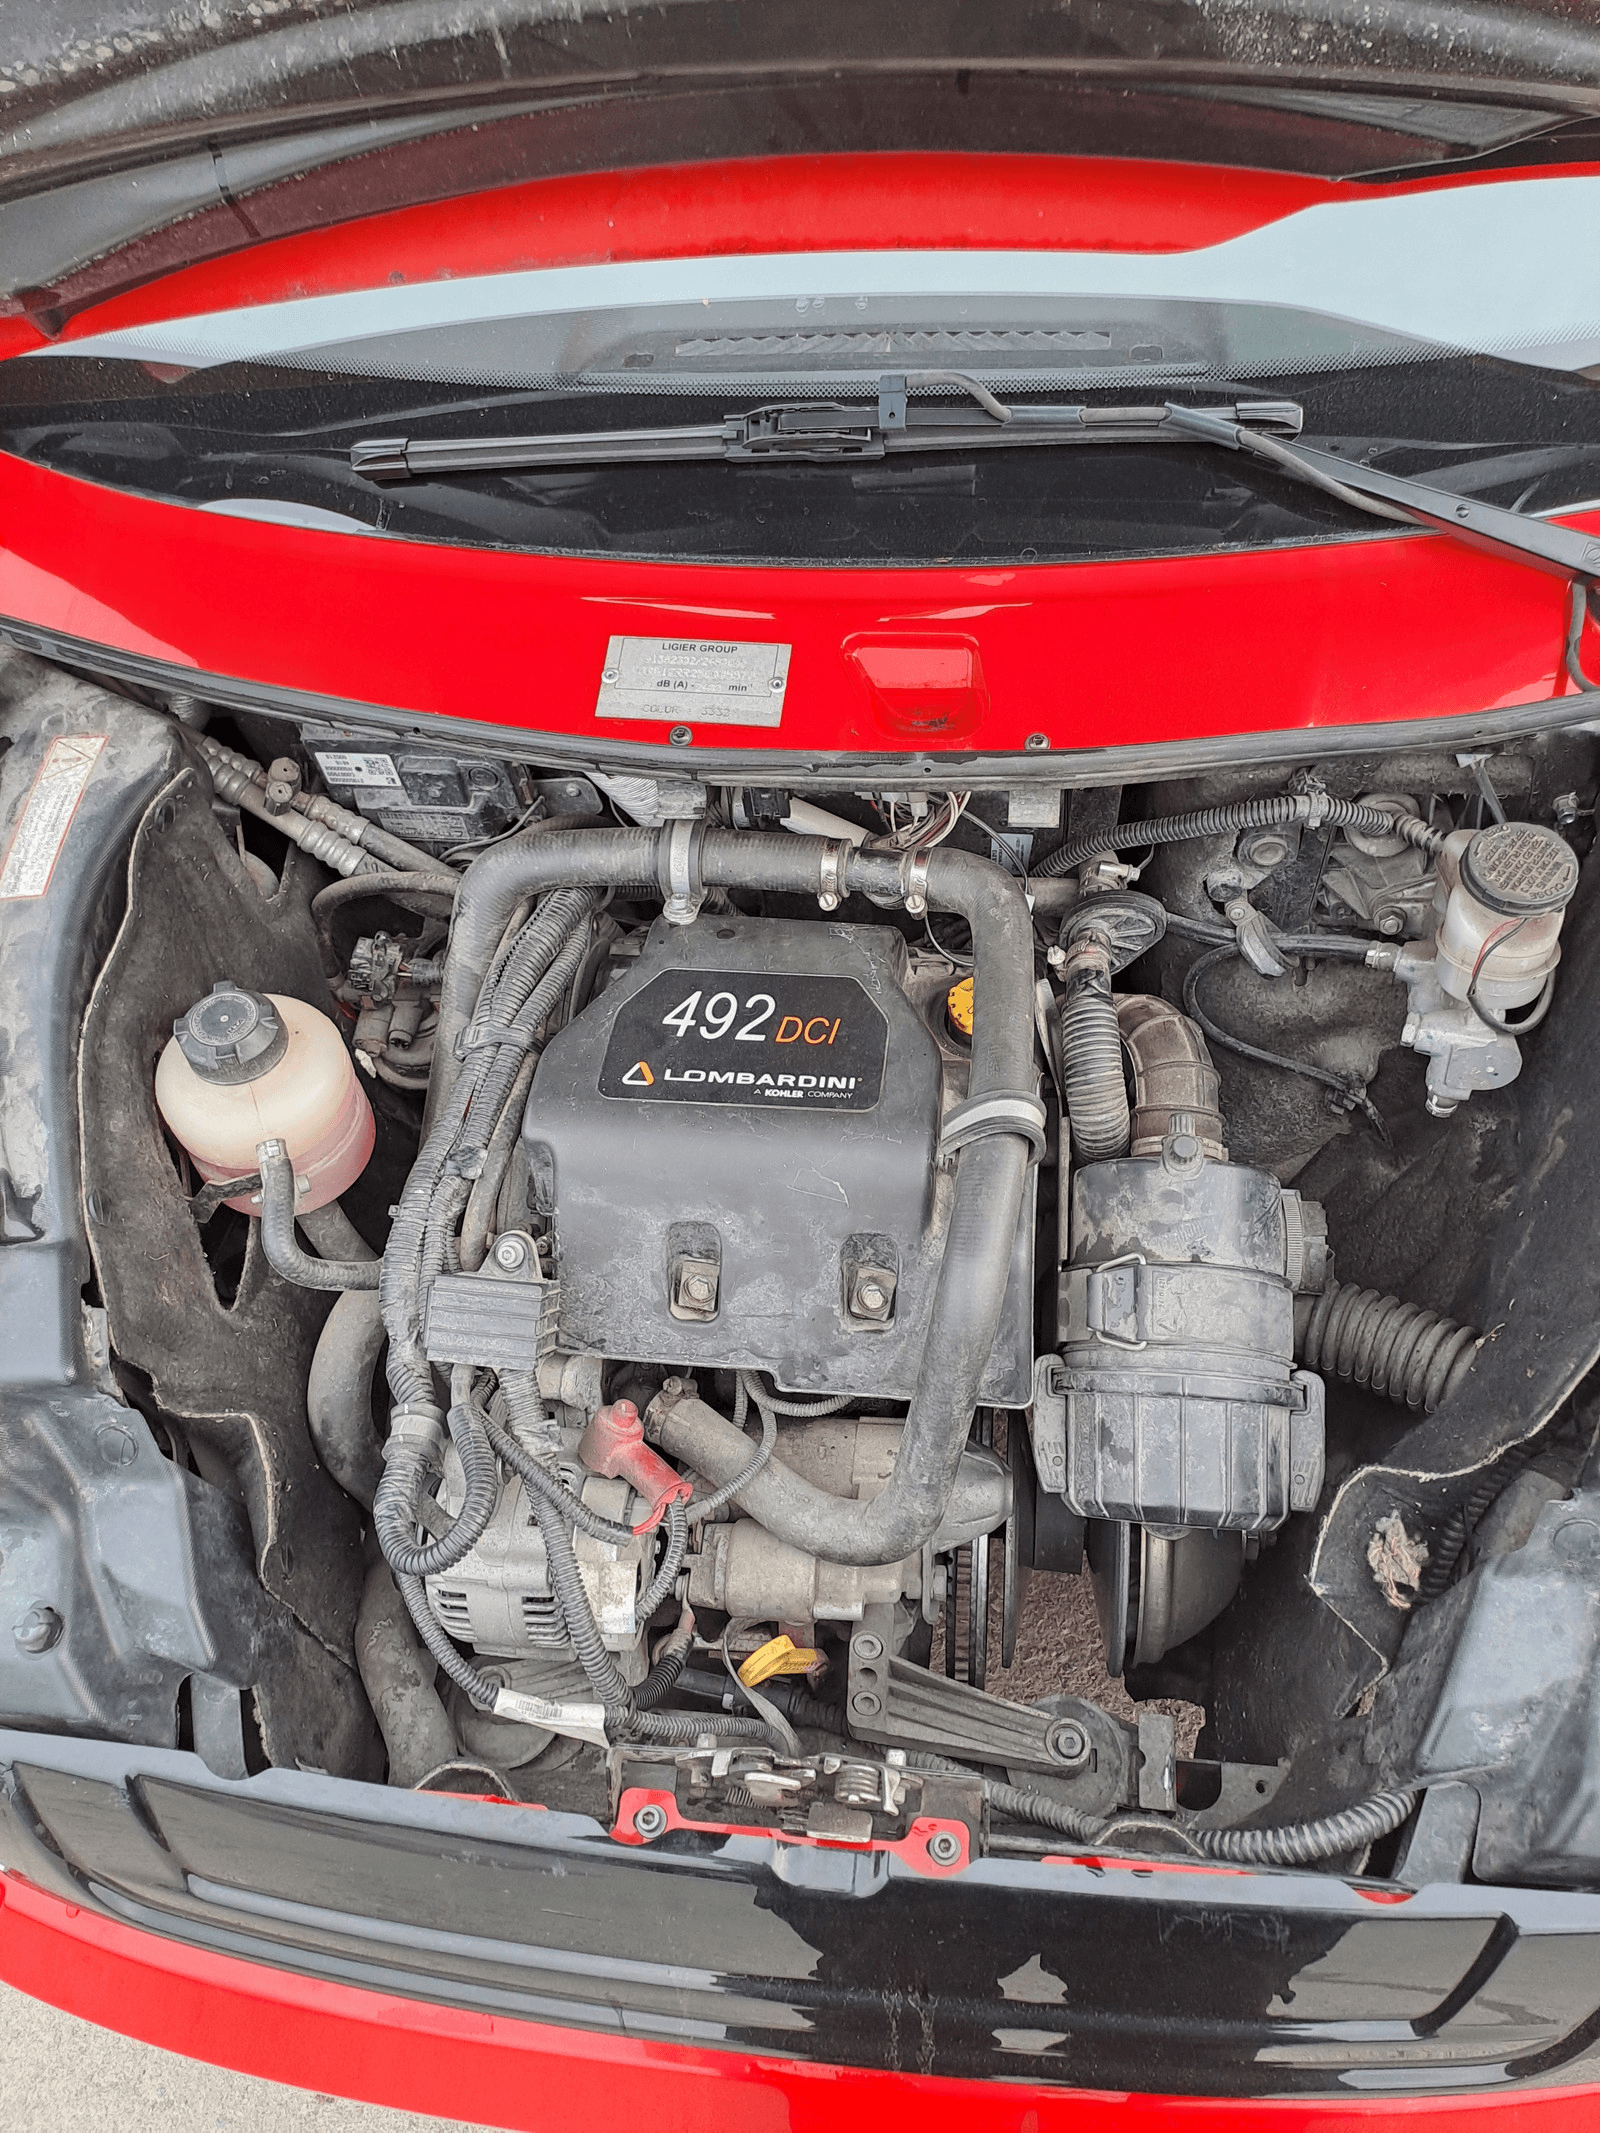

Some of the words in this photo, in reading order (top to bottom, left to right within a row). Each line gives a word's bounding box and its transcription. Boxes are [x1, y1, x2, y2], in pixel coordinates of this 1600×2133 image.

[662, 642, 696, 652] LIGIER
[699, 644, 738, 654] GROUP
[656, 679, 670, 688] dB
[673, 679, 688, 690] (A)
[662, 990, 776, 1042] 492
[774, 1015, 842, 1046] DCI
[663, 1068, 857, 1090] LOMBARDINI
[764, 1088, 804, 1099] KOHLER
[807, 1090, 853, 1099] COMPANY
